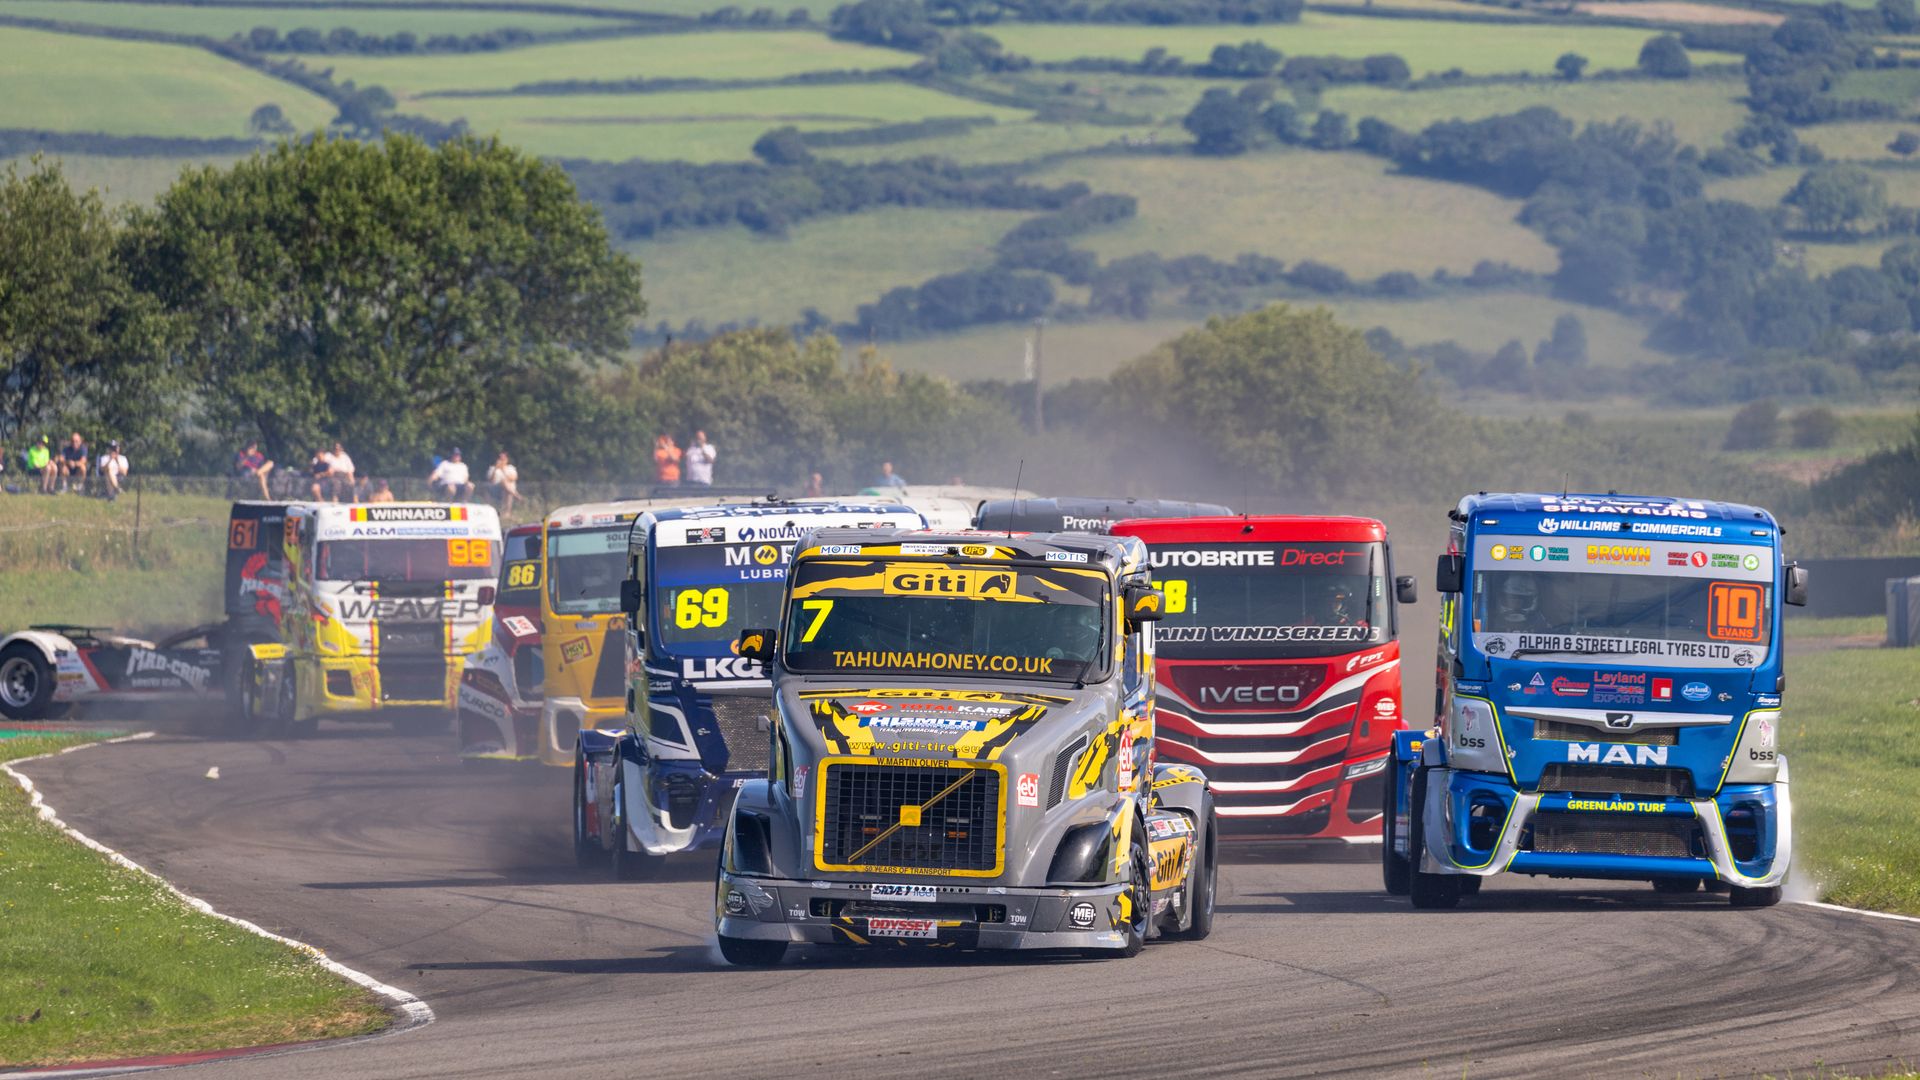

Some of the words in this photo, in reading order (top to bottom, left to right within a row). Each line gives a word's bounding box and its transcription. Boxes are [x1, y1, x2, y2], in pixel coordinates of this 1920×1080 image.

[371, 508, 446, 521] WINNARD
[232, 522, 255, 547] 61
[1560, 519, 1622, 532] WILLIAMS
[1632, 522, 1722, 537] COMMERCIALS
[452, 539, 489, 565] 96
[820, 545, 860, 554] MOTIS
[964, 545, 986, 555] UPG
[1046, 552, 1087, 561] MOTIS
[1586, 544, 1651, 561] BROWN
[1148, 550, 1275, 568] UTOBRITE
[1281, 548, 1364, 566] Direct
[508, 564, 536, 587] 86
[892, 573, 968, 593] Giti
[338, 600, 482, 619] WEAVER
[675, 587, 729, 629] 69
[1714, 587, 1757, 627] 10
[801, 600, 835, 643] 7
[1211, 626, 1381, 642] WINDSCREENS
[1717, 627, 1753, 639] EVANS
[1519, 635, 1560, 650] ALPHA
[1565, 637, 1573, 650] &
[1575, 638, 1623, 653] STREET
[1625, 640, 1664, 655] LEGAL
[1667, 643, 1706, 658] TYRES
[1709, 646, 1730, 659] LTD
[833, 651, 1053, 675] TAHUNAHONEY.CO.UK
[1360, 651, 1384, 665] FPT
[683, 656, 765, 679] LKQ
[1594, 671, 1646, 688] Leyland
[1200, 685, 1300, 704] IVECO
[1593, 693, 1645, 704] EXPORTS
[849, 740, 981, 754] www.giti-tire.eu
[1460, 734, 1485, 748] bss
[1567, 743, 1668, 765] MAN
[1750, 748, 1773, 761] bss
[920, 759, 950, 768] OLIVER
[1017, 774, 1040, 797] febi
[1567, 800, 1635, 812] GREENLAND
[1637, 802, 1666, 813] TURF
[910, 867, 951, 876] TRANSPORT
[1157, 848, 1176, 883] Giti
[789, 909, 806, 918] TOW
[1010, 915, 1027, 923] TOW
[1074, 907, 1095, 918] MEI
[870, 919, 933, 931] ODYSSEY
[870, 929, 929, 937] BATTERY
